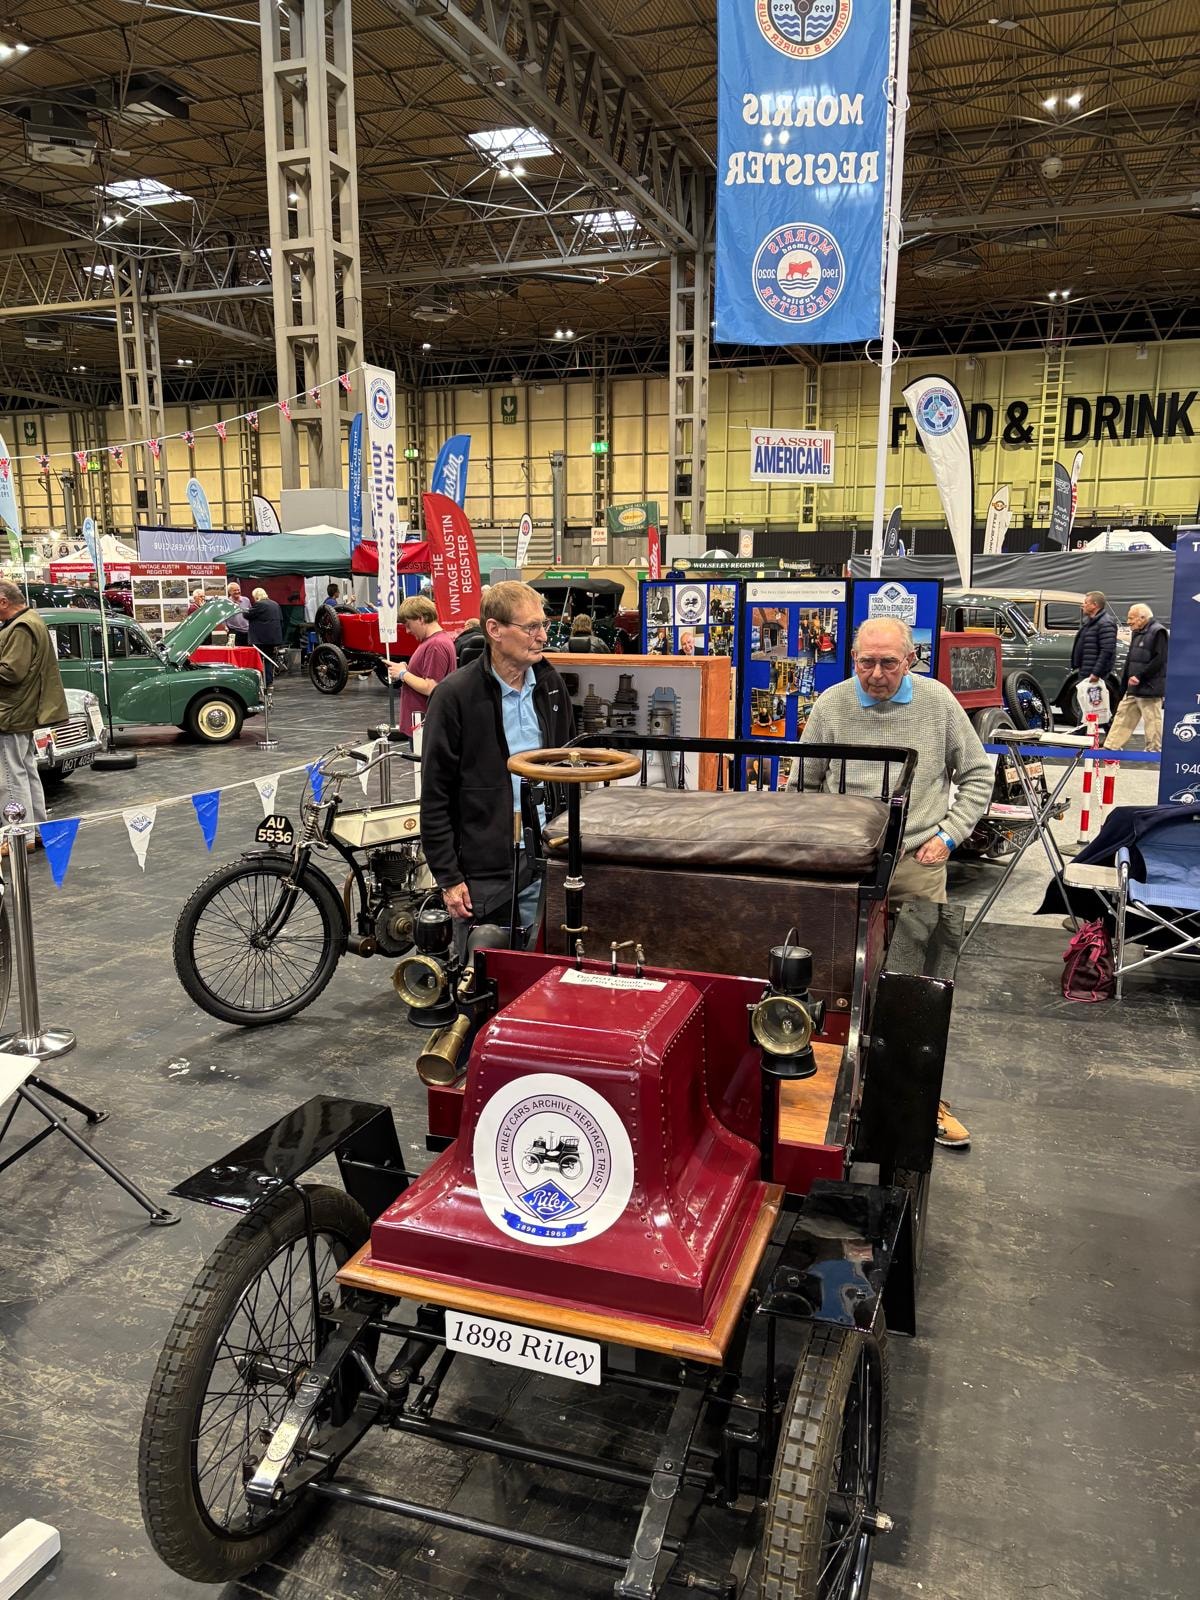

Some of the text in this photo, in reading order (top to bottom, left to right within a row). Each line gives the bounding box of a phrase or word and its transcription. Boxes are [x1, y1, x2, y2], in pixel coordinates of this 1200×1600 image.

[754, 436, 823, 447] CLASSIC
[892, 402, 994, 448] FD
[1002, 400, 1034, 444] &
[1064, 390, 1199, 441] DRINK
[384, 444, 394, 501] Club
[437, 453, 464, 503] ustin
[754, 446, 823, 475] AMERICAN
[441, 514, 455, 560] AUSTIN
[433, 553, 444, 578] THE
[457, 534, 473, 594] REGISTER
[693, 561, 730, 569] WOLSELEY
[730, 561, 765, 569] REGISTER
[447, 563, 461, 615] VINTAGE
[257, 828, 292, 843] 5536
[265, 816, 286, 829] AU
[500, 1099, 606, 1190] THE RILEY CARS ARCHIVE HERITAGE TRUST
[529, 1190, 570, 1215] Riley
[452, 1321, 595, 1375] 1898 Riley
